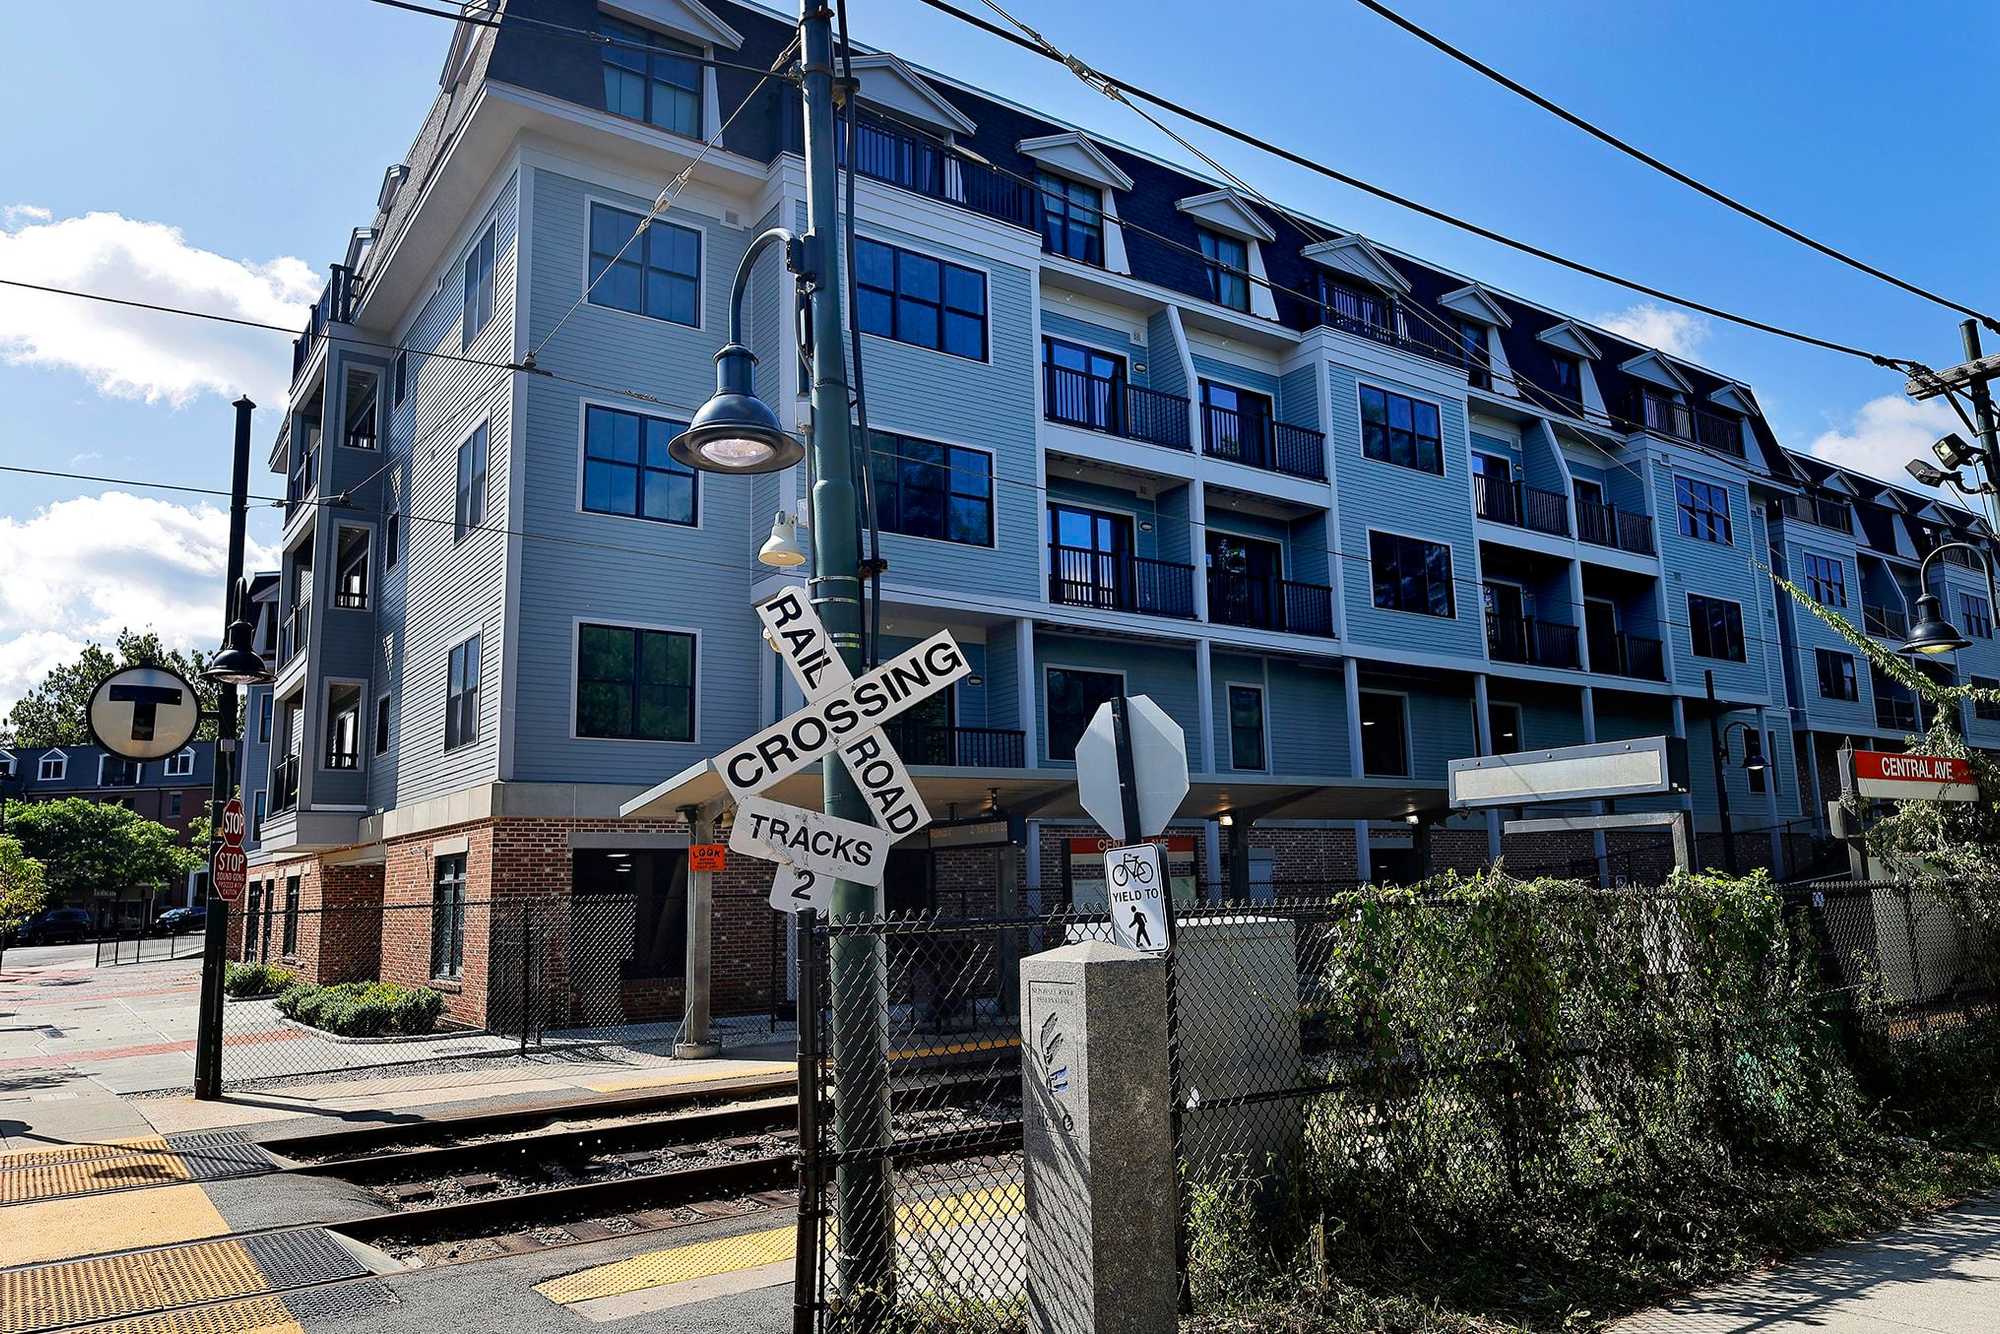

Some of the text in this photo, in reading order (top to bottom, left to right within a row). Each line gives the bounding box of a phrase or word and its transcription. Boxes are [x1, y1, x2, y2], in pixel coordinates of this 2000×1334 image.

[765, 592, 834, 691] RAIL
[109, 684, 182, 742] T
[727, 642, 963, 789] CROSSING
[845, 734, 919, 836] ROAD
[1881, 756, 1933, 779] CENTRAL
[224, 811, 244, 835] STOP
[749, 812, 873, 867] TRACKS
[218, 852, 245, 872] STOP
[790, 869, 816, 903] 2
[1112, 887, 1159, 903] YIELD TO
